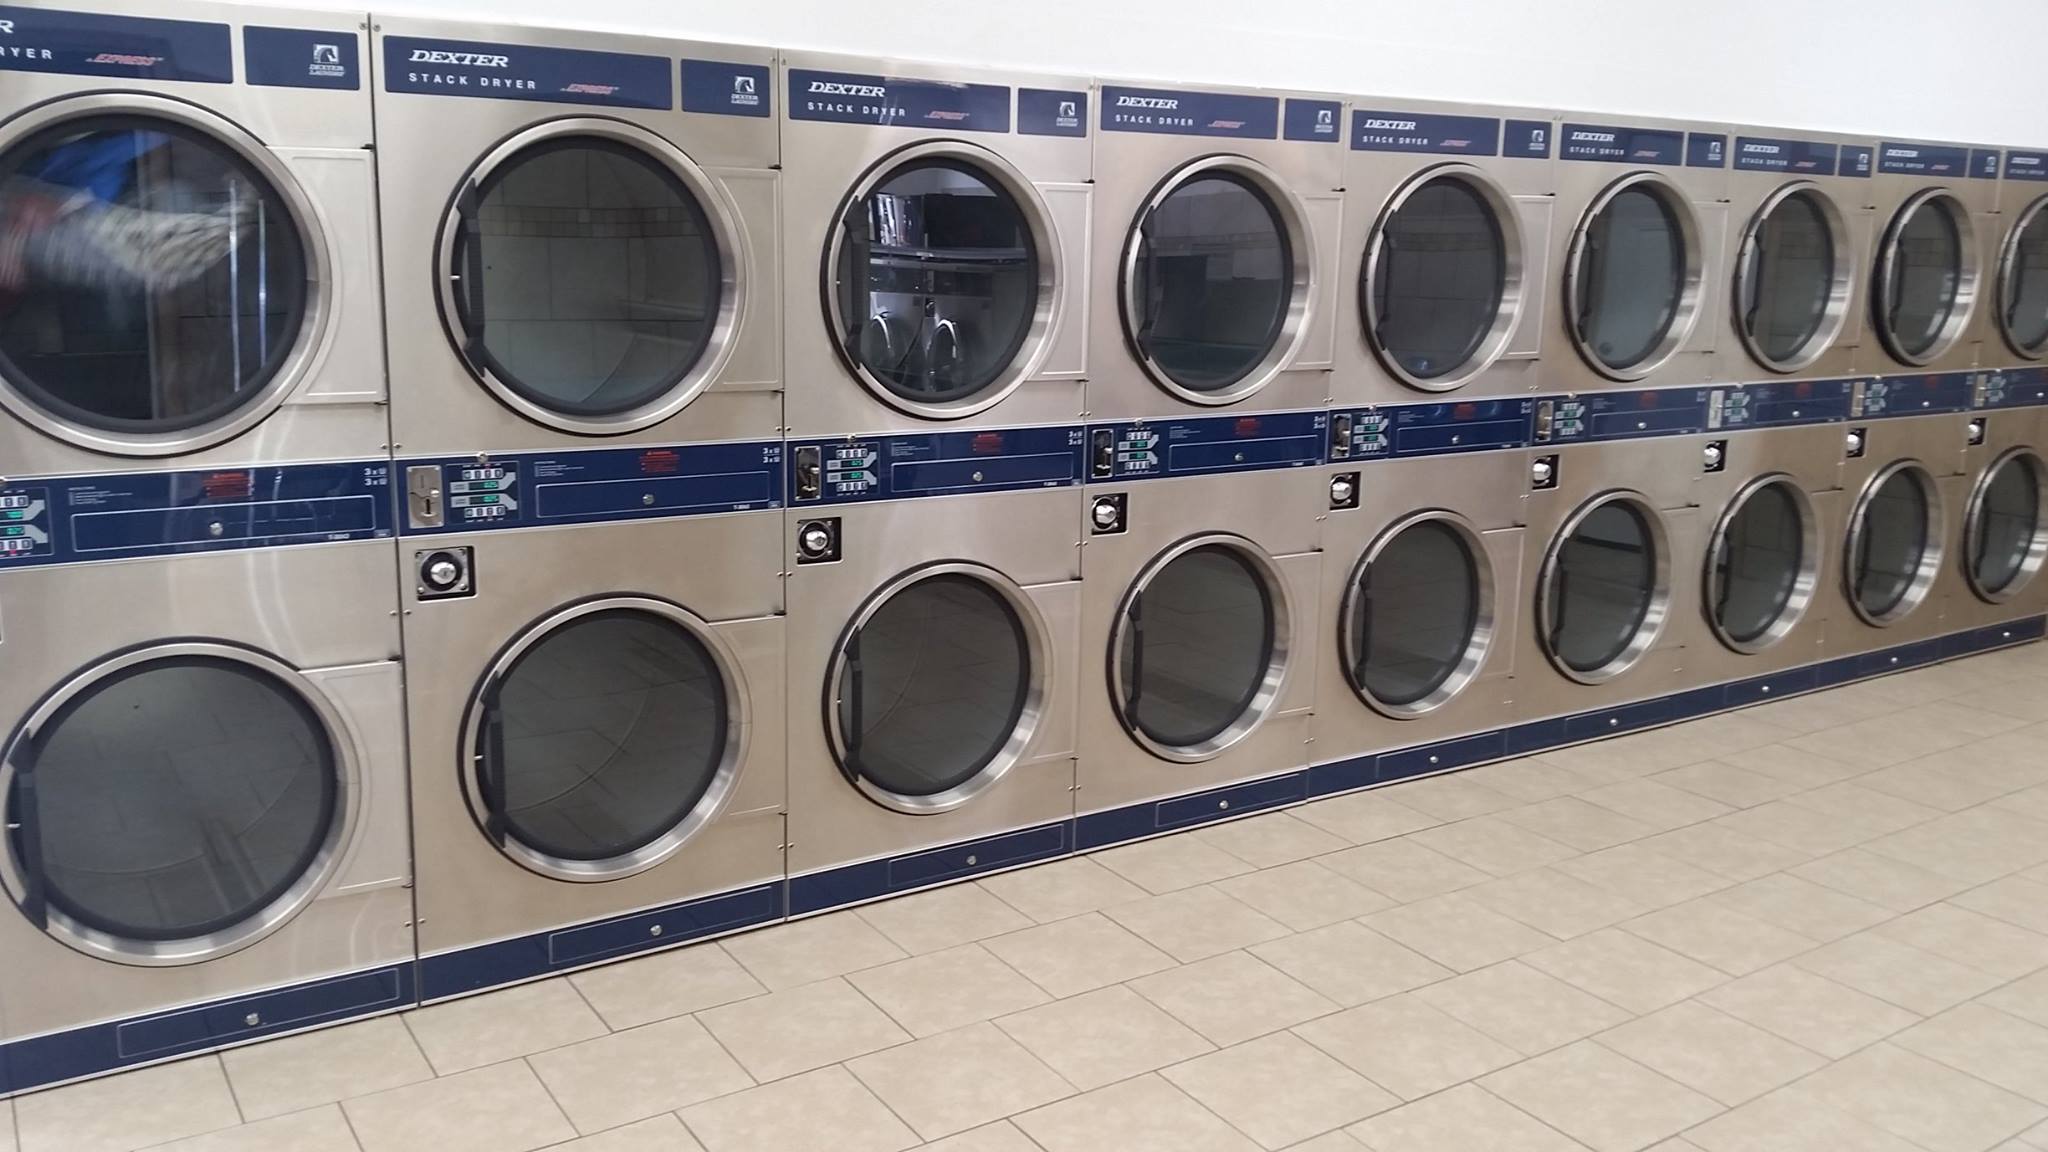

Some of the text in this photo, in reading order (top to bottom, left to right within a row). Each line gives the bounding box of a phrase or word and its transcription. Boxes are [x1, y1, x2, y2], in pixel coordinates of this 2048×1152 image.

[408, 50, 509, 68] DEXTER
[408, 72, 536, 90] STACK DRYER
[808, 81, 885, 97] DEXTER
[807, 102, 906, 117] STACK DRYER
[1116, 96, 1178, 109] DEXTER
[1115, 114, 1193, 126] STACK DRYER
[1363, 119, 1416, 130] DEXTER
[1362, 135, 1393, 143] STACK
